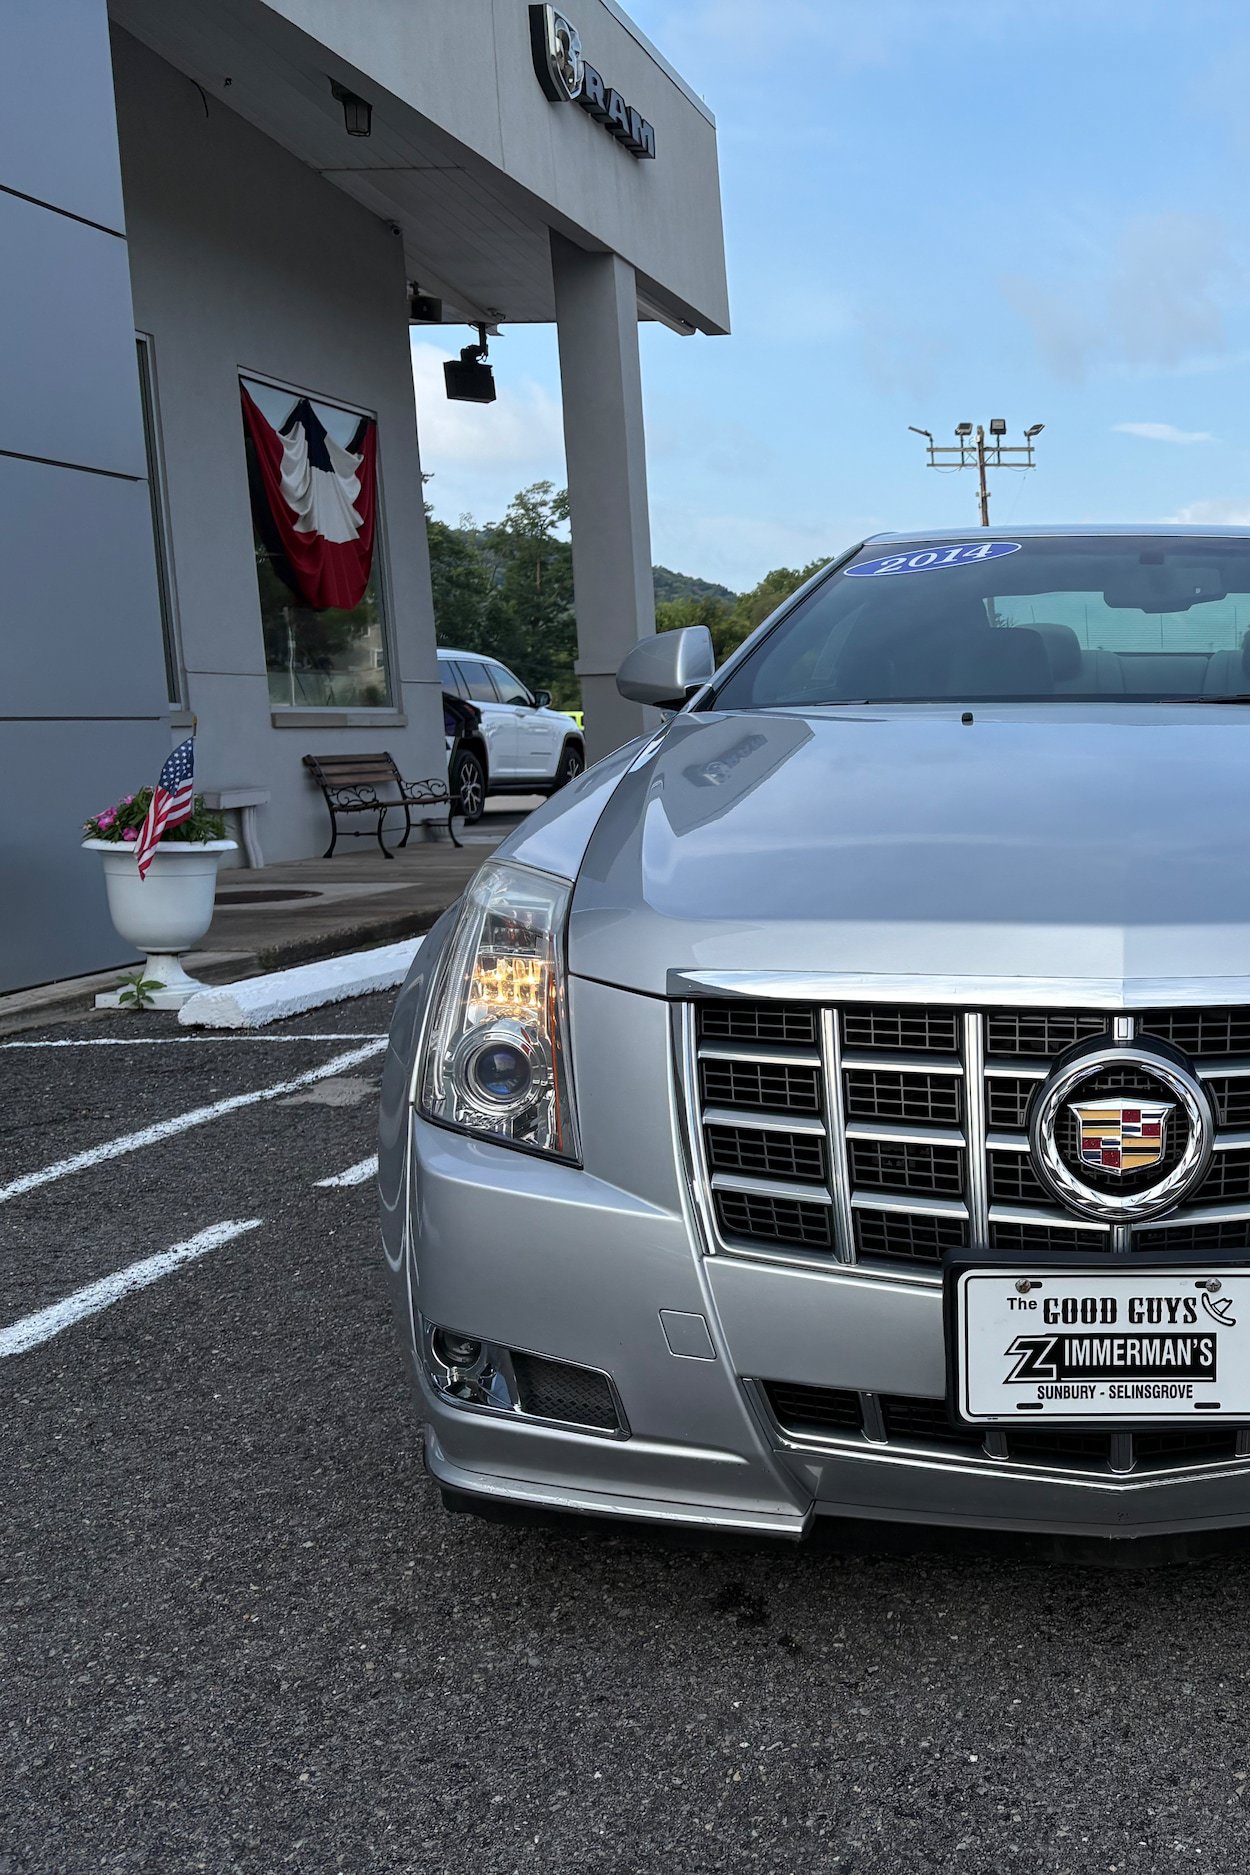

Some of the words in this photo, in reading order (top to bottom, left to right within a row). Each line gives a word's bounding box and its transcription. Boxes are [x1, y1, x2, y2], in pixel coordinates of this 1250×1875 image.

[582, 60, 656, 160] RAM
[873, 544, 994, 575] 2014
[1006, 1297, 1038, 1311] The
[1042, 1297, 1118, 1325] GOOD
[1128, 1297, 1198, 1325] GUYS
[1003, 1335, 1214, 1385] ZIMMERMAN'S
[1037, 1385, 1097, 1400] SUNBURY
[1108, 1384, 1193, 1400] SELINSGROVE
